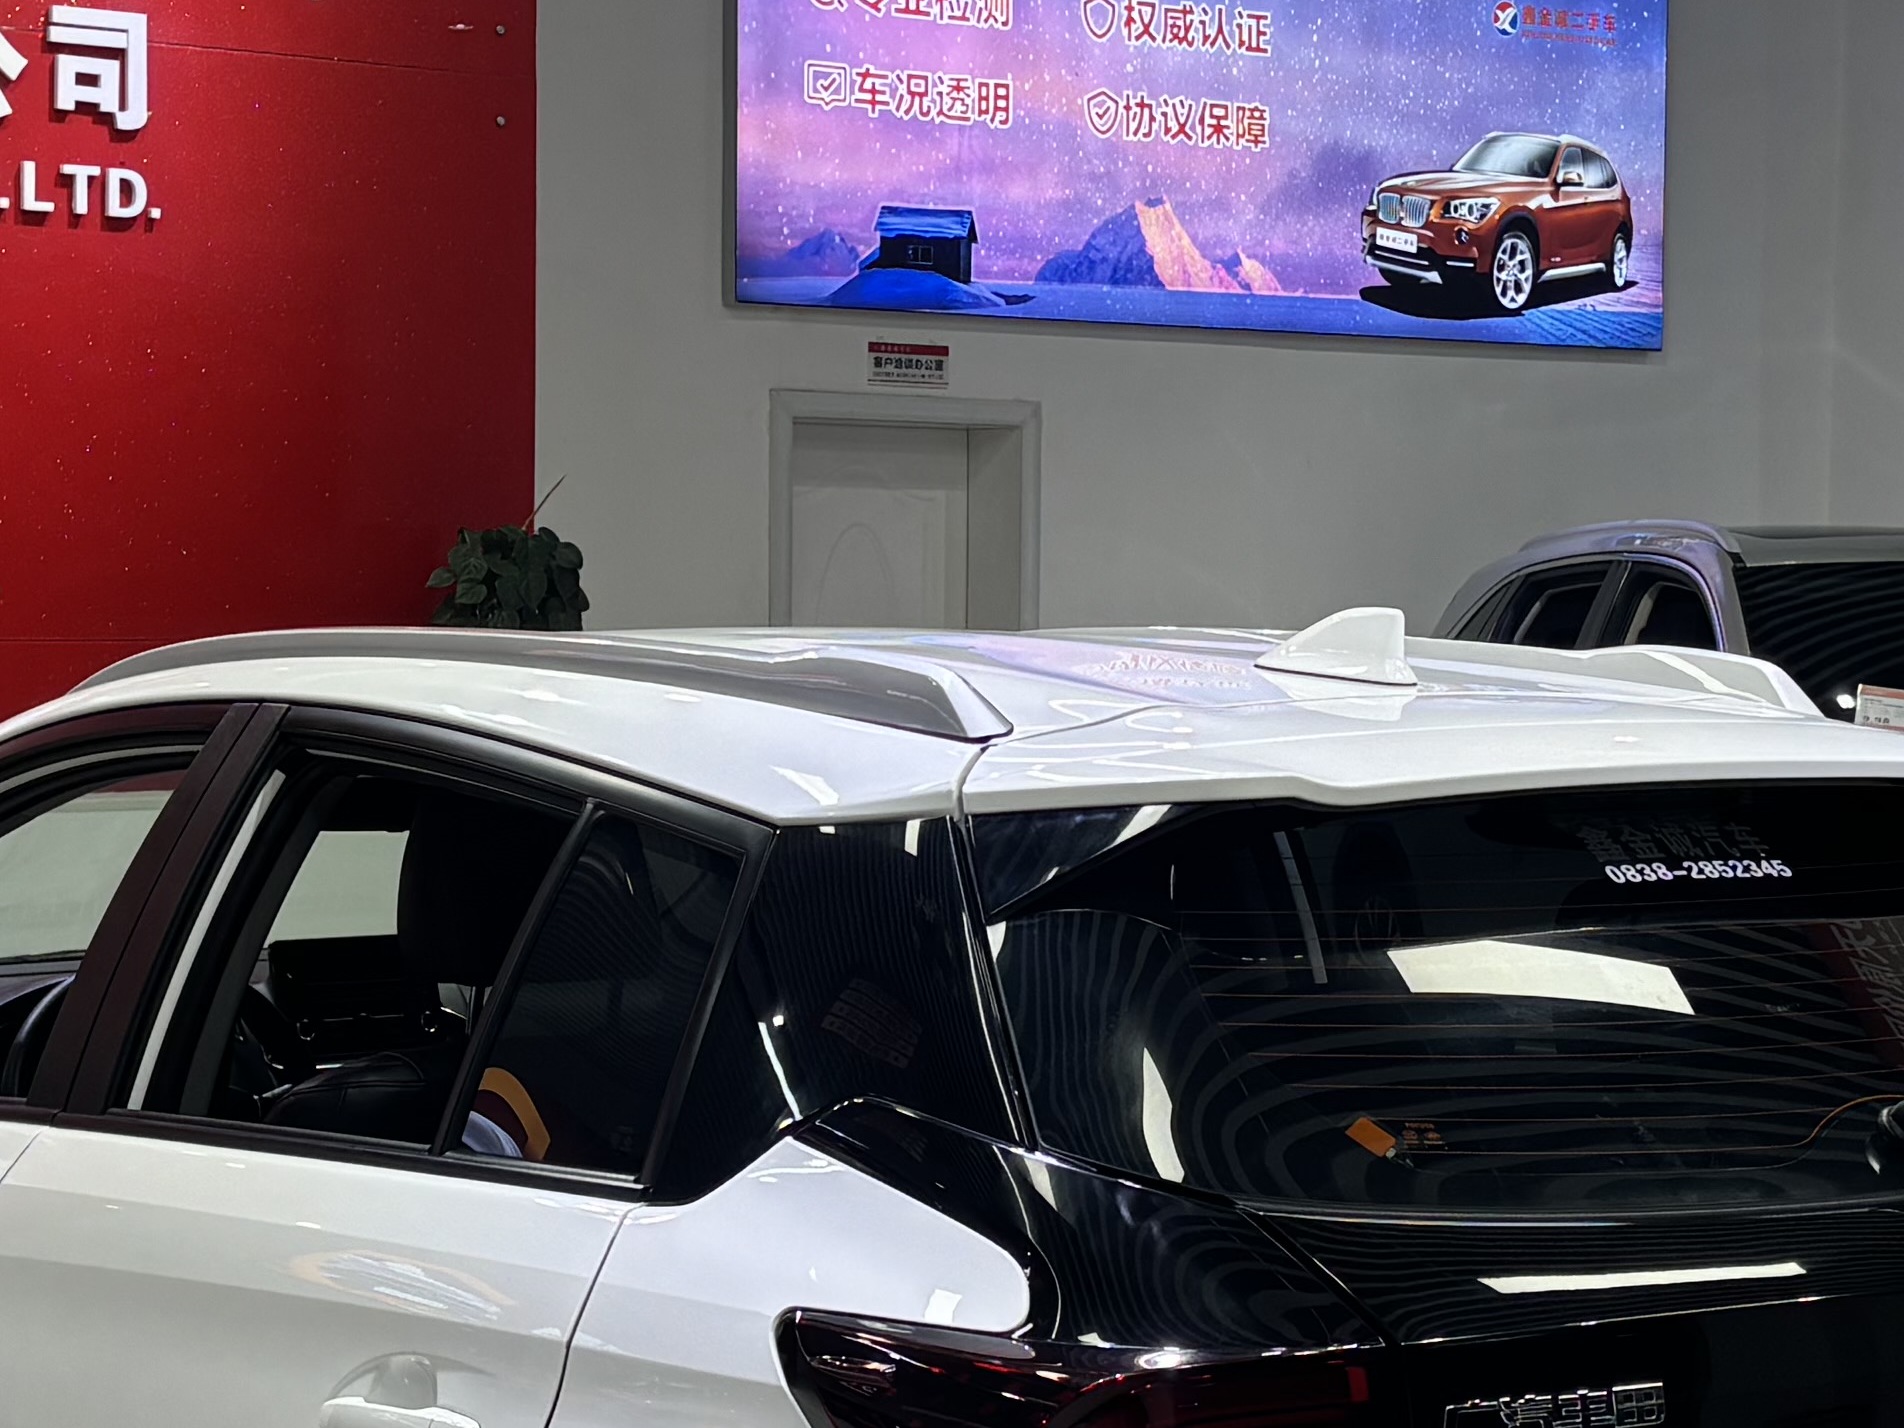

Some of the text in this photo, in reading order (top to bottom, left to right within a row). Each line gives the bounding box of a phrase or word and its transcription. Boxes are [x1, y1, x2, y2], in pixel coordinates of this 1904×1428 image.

[852, 65, 1270, 153] 车况透明 协议保障
[1604, 859, 1793, 884] 0838-2852345
